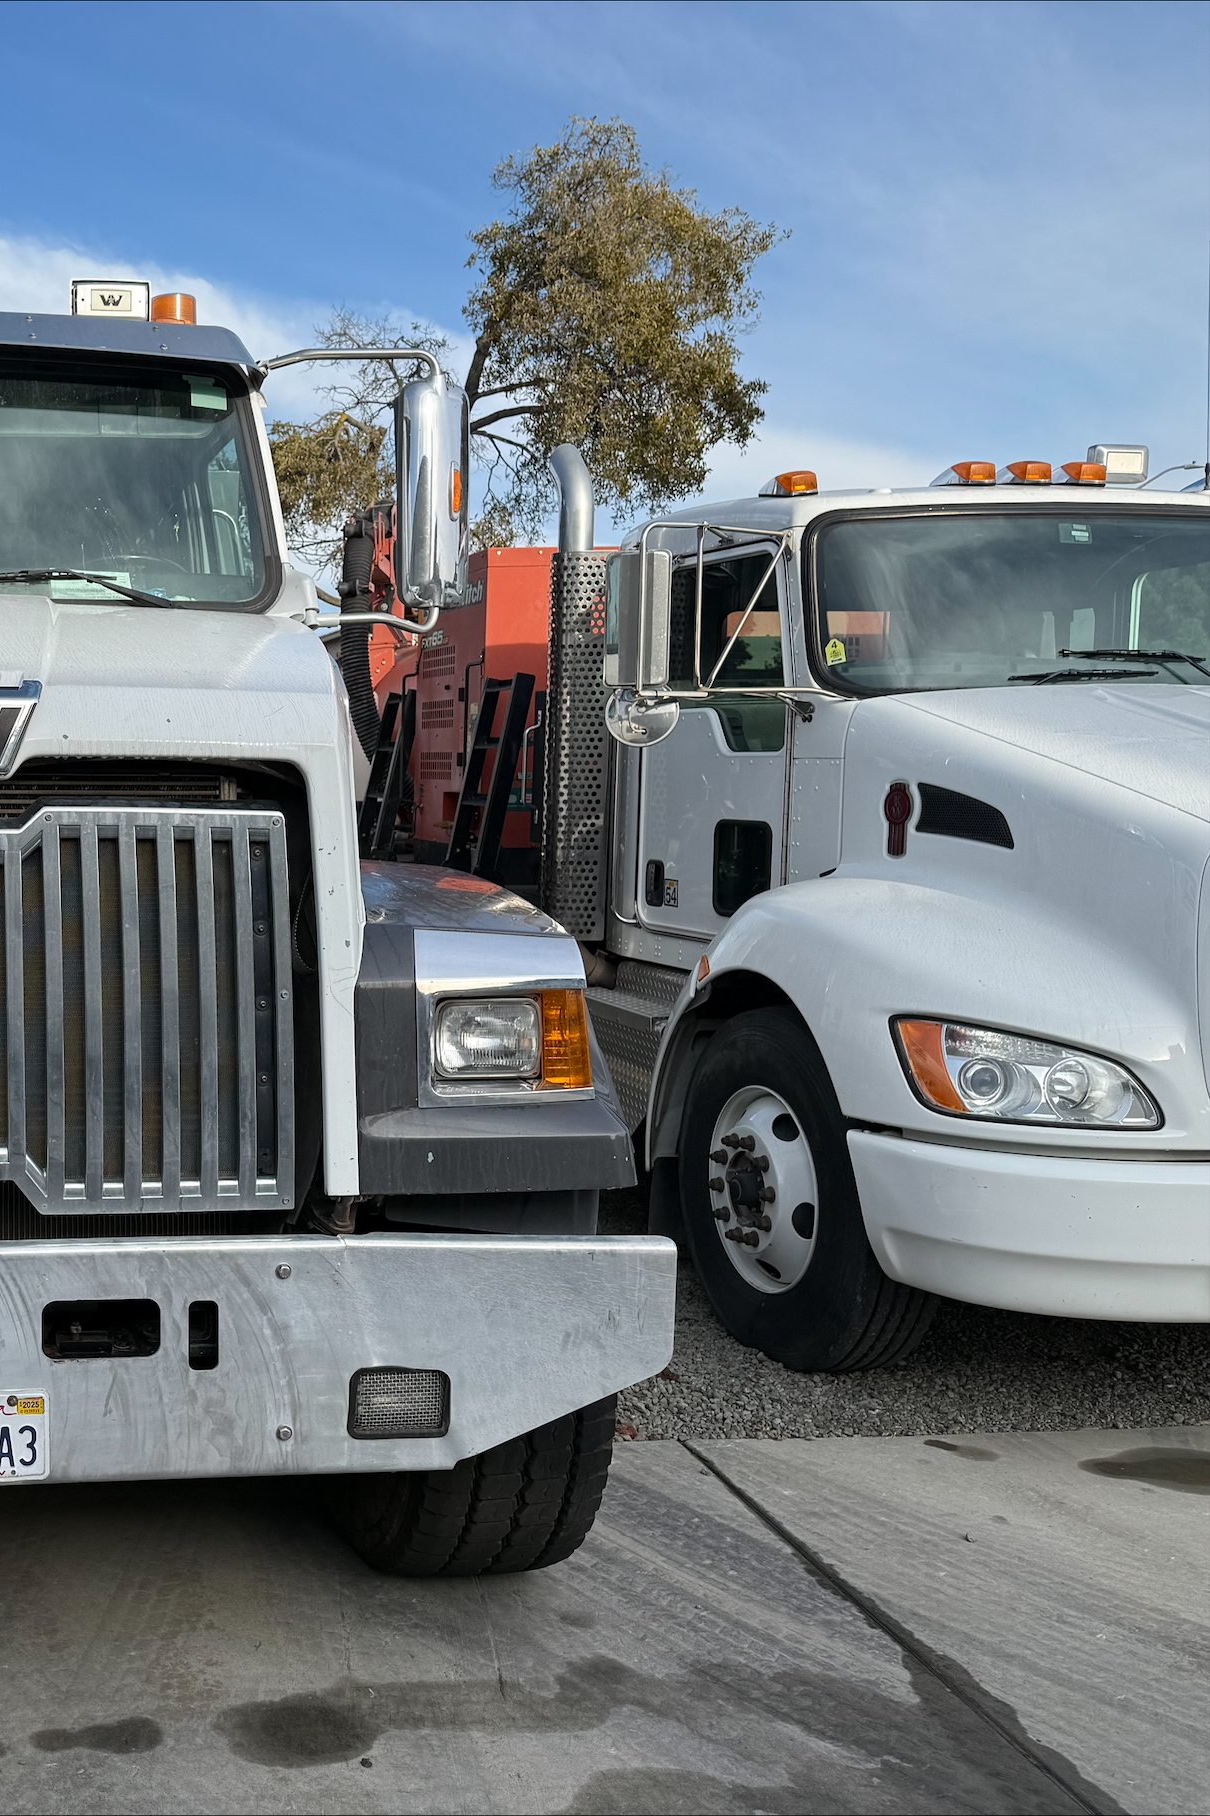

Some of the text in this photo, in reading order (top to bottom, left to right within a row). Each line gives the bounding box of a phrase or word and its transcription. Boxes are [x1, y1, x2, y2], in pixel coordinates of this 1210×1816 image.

[462, 580, 483, 606] itch
[421, 629, 444, 649] FXT65
[831, 641, 837, 649] 4
[665, 886, 677, 905] 54
[22, 1400, 40, 1409] 2025
